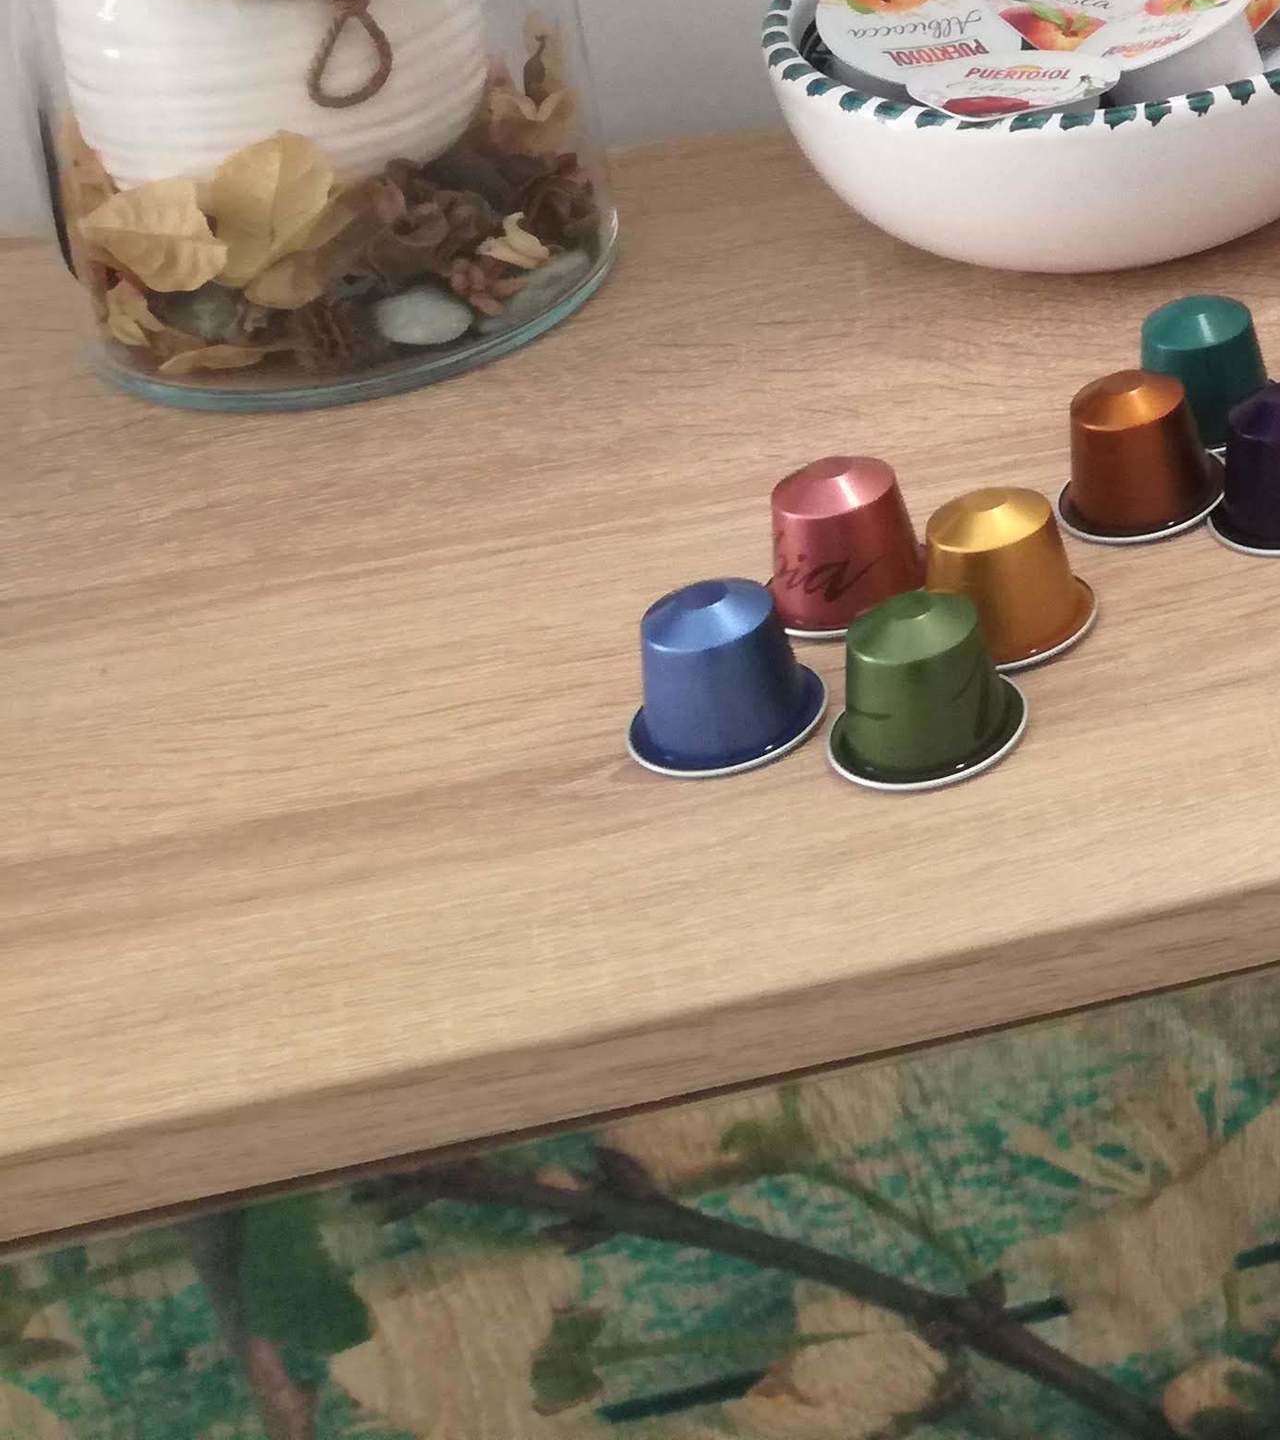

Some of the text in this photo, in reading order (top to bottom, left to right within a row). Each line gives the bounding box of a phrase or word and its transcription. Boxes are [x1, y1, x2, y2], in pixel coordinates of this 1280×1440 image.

[848, 8, 982, 39] Albicocca
[883, 38, 990, 66] PUERTOSOL
[963, 66, 1072, 80] PUERTOSOL
